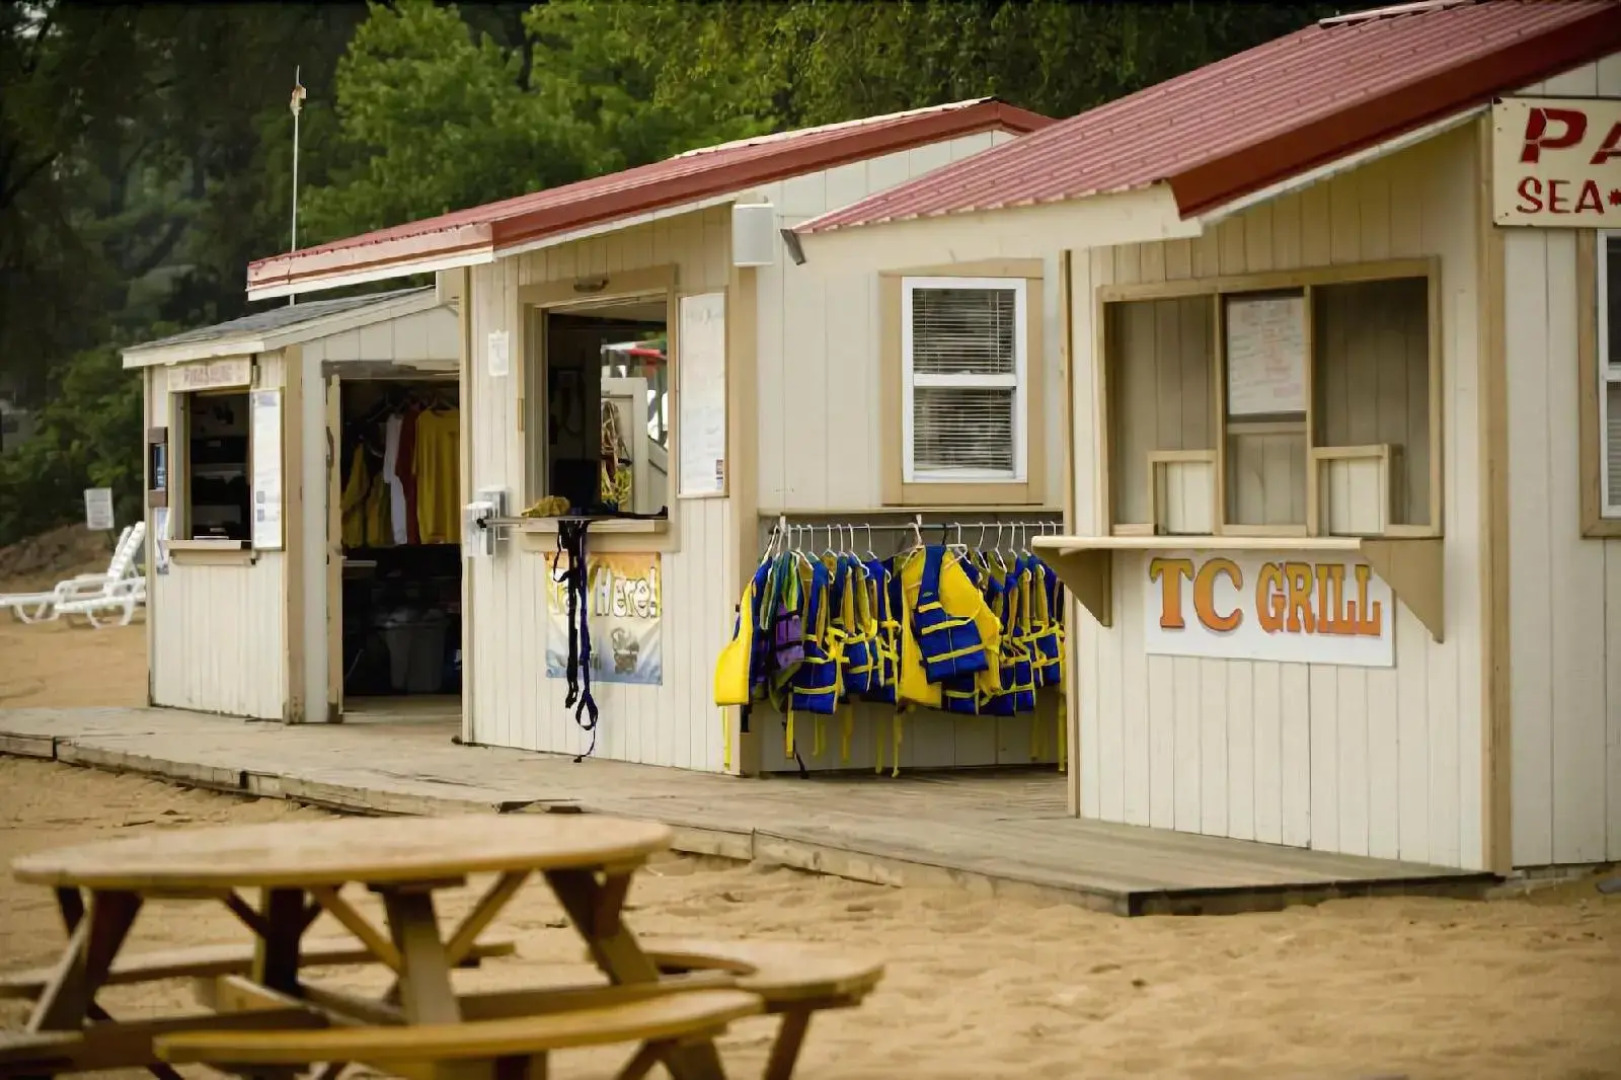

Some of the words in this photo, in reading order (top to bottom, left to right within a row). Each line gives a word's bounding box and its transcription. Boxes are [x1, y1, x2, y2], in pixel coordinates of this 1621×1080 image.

[594, 566, 657, 618] Here!
[1149, 556, 1244, 632] TC
[1255, 561, 1382, 636] GRILL
